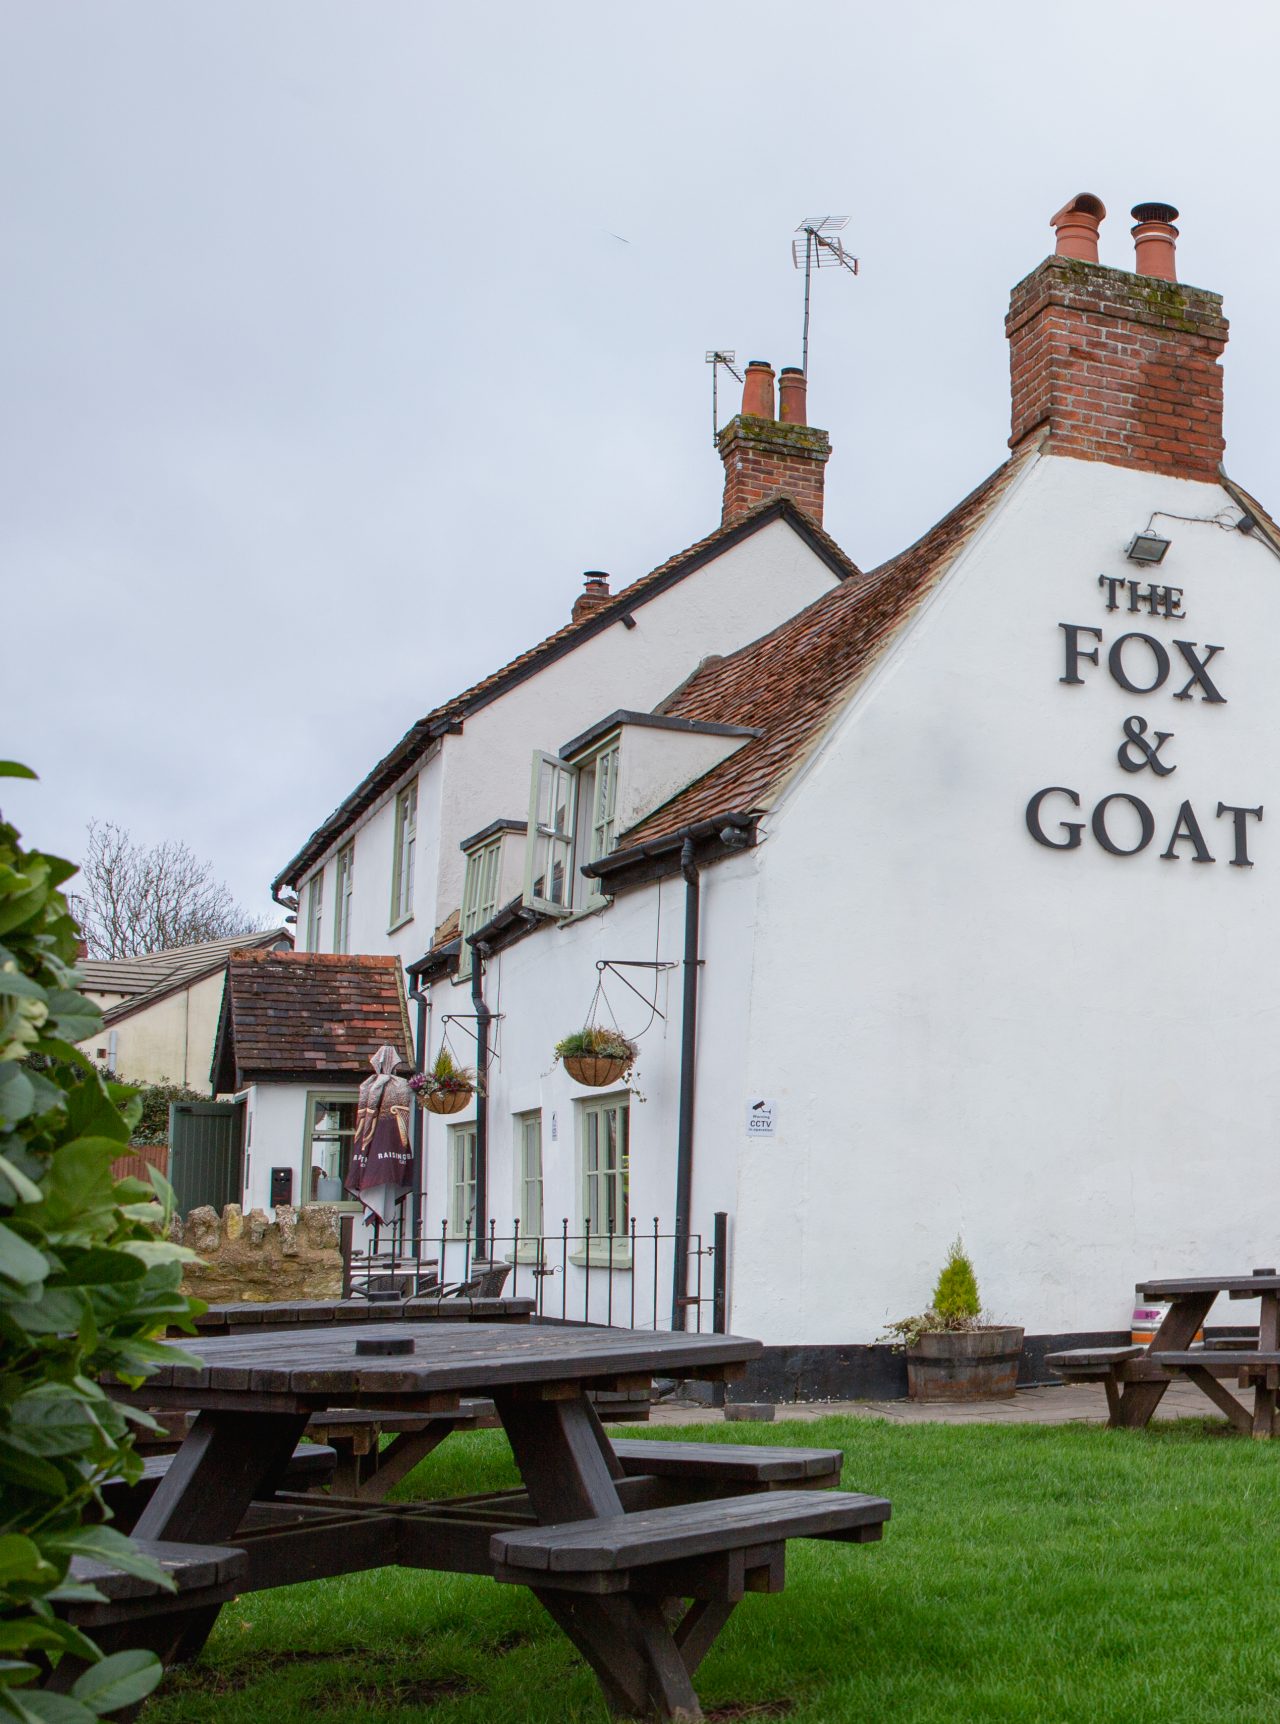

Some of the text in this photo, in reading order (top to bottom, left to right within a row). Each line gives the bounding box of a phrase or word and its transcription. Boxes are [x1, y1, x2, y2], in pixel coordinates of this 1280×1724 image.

[1098, 574, 1187, 619] THE
[1058, 622, 1228, 704] FOX
[1117, 715, 1177, 776] &
[1025, 786, 1264, 867] GOAT
[750, 1120, 772, 1128] CCTV
